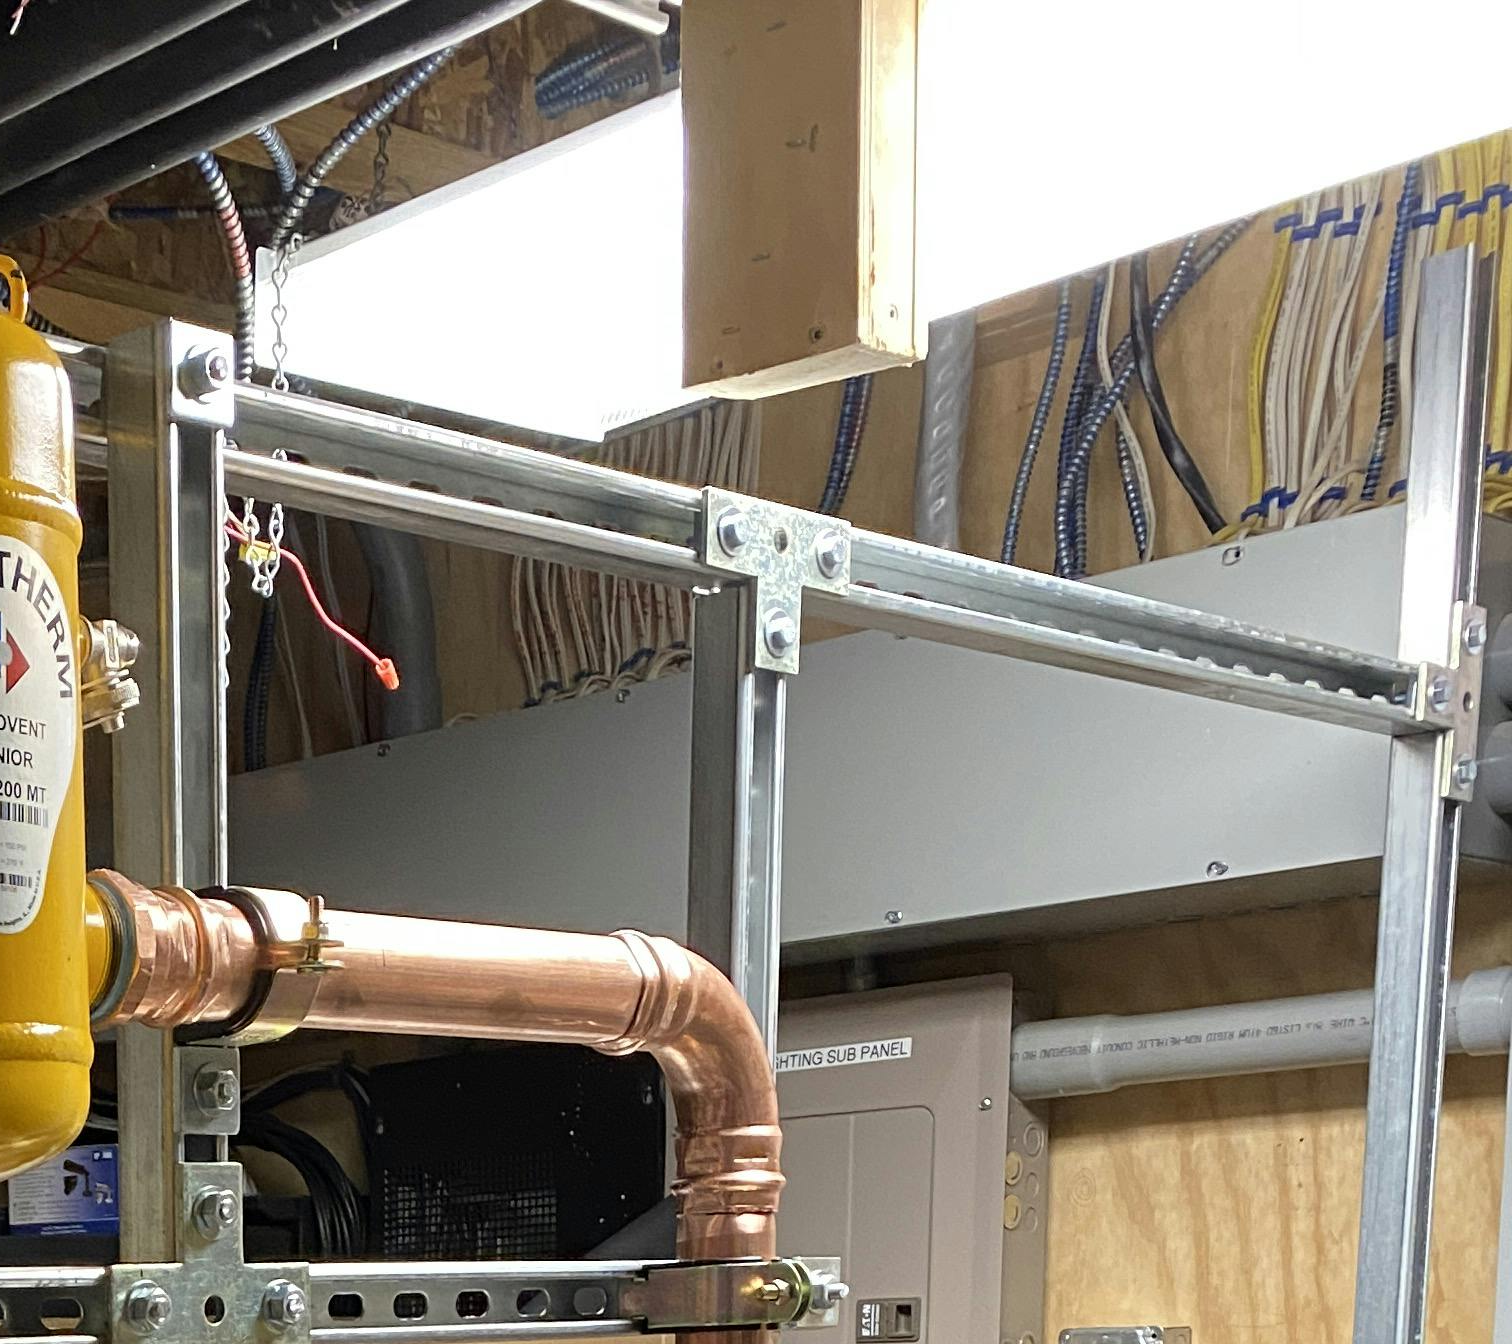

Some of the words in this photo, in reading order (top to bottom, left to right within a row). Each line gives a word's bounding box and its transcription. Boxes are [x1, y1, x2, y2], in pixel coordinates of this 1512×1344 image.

[27, 784, 47, 804] MT
[1205, 1030, 1235, 1042] RIGID
[826, 1046, 857, 1064] SUB
[861, 1041, 908, 1060] PANEL
